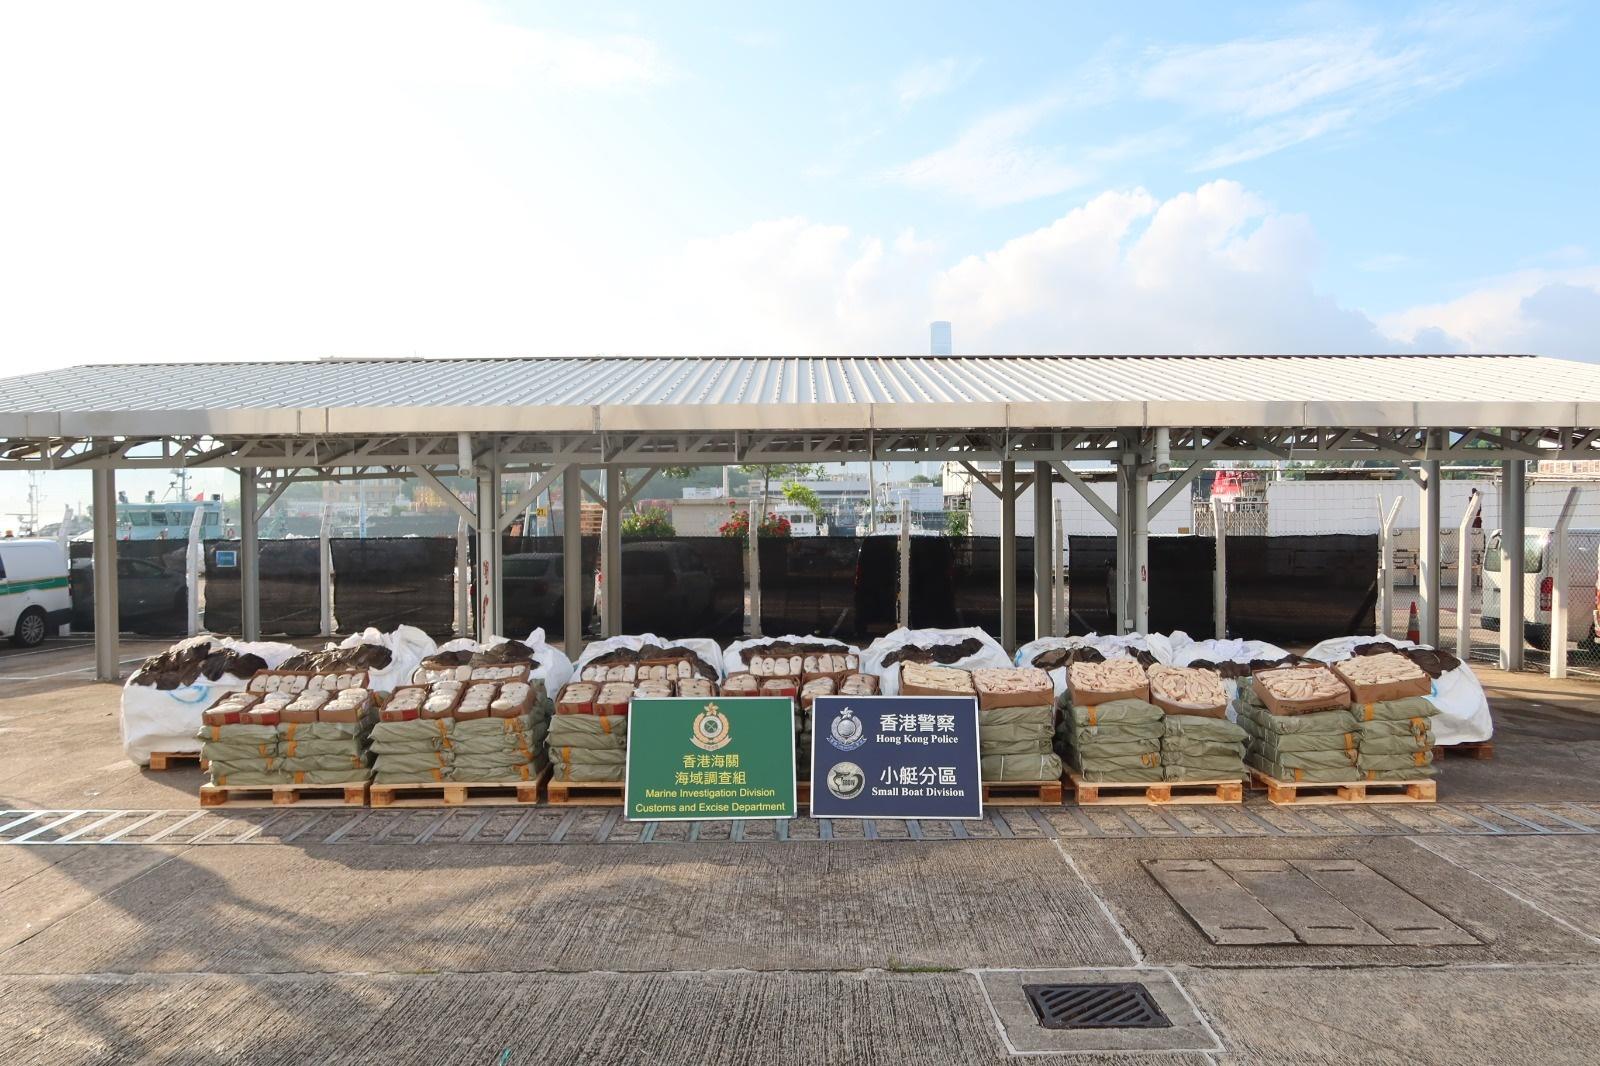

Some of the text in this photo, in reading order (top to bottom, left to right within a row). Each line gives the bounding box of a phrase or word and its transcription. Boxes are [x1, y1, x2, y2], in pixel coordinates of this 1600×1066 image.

[879, 714, 955, 733] 香港警察
[876, 734, 901, 745] Hong
[904, 734, 929, 745] Kong
[931, 734, 959, 744] Police
[682, 754, 740, 768] 香港海關
[674, 771, 747, 785] 海域調查組
[879, 766, 958, 785] 小艇分區
[645, 788, 775, 799] Marine Investigation Division
[871, 787, 965, 797] Small Boat Division
[635, 802, 786, 813] Customs and Excise Department
